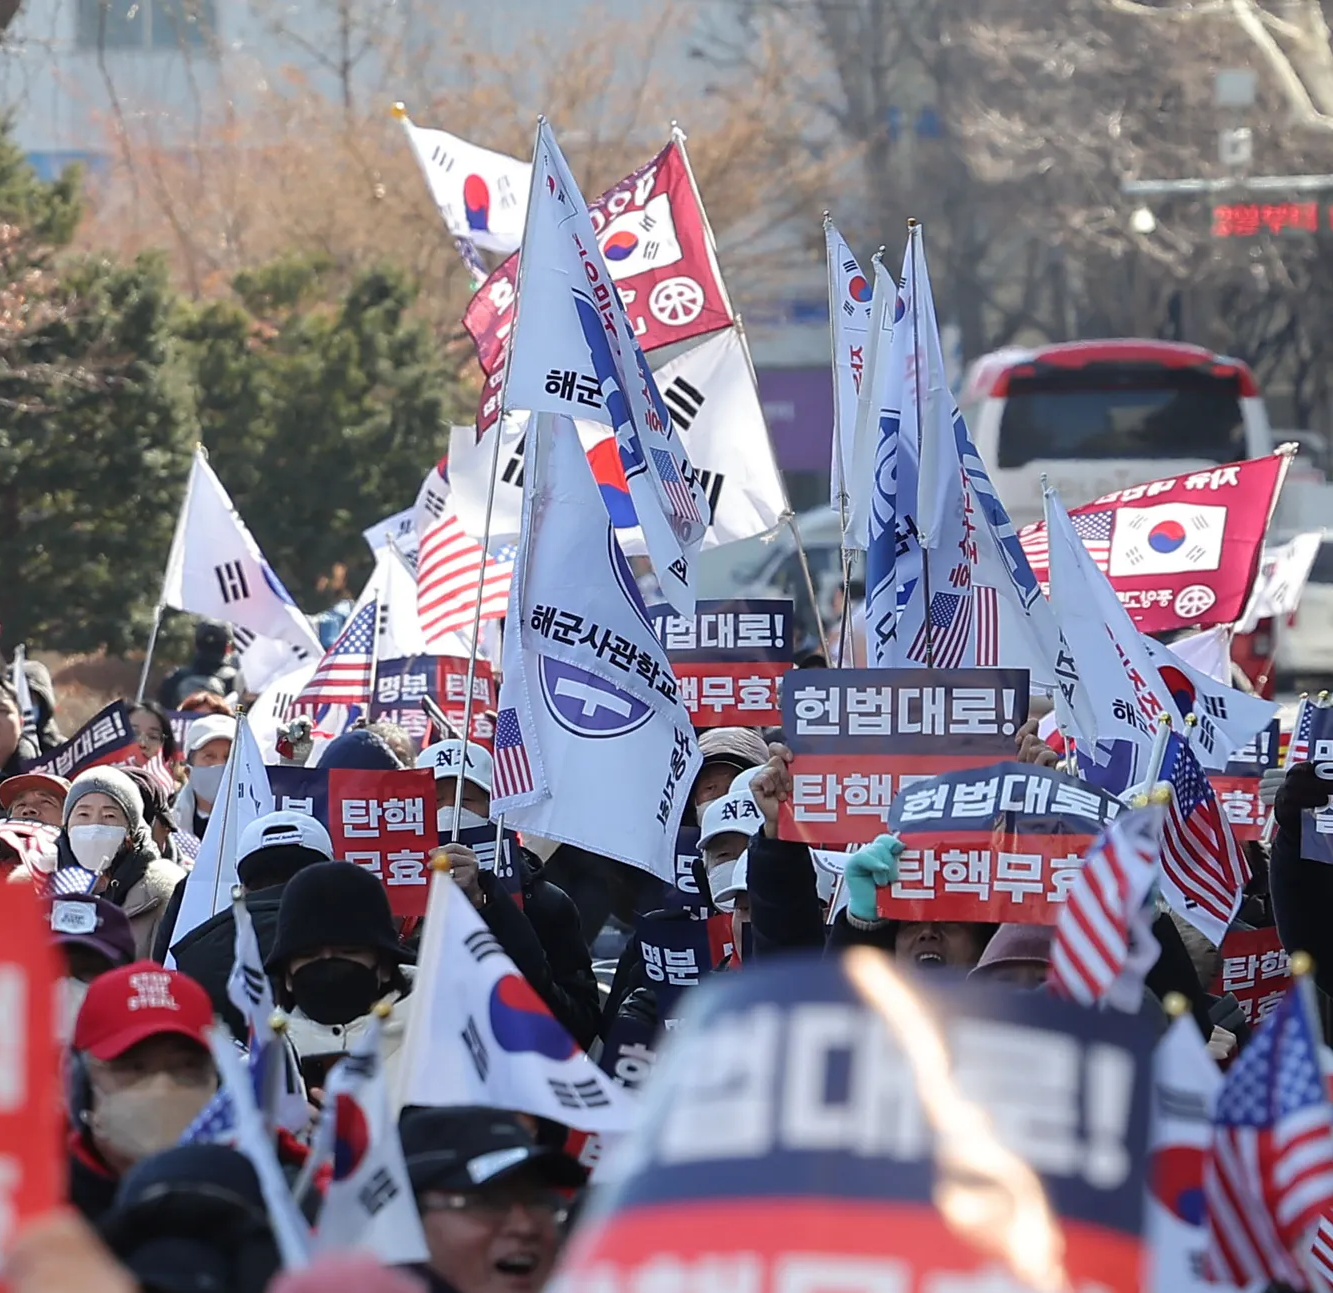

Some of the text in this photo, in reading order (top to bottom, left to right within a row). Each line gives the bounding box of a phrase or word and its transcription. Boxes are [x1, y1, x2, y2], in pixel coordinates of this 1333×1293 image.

[531, 604, 679, 704] 해군사관학교
[378, 673, 429, 703] 명분
[794, 685, 1017, 736] 헌법대로!
[342, 797, 424, 838] 탄핵
[720, 799, 762, 821] NA
[793, 773, 937, 823] 탄핵
[900, 773, 1122, 826] 헌법대로!
[344, 849, 427, 886] 무효
[129, 971, 173, 987] STOP
[640, 940, 700, 987] 명분
[1221, 947, 1293, 993] 탄핵
[127, 995, 181, 1012] STEAL
[658, 1003, 1135, 1190] 법대로!
